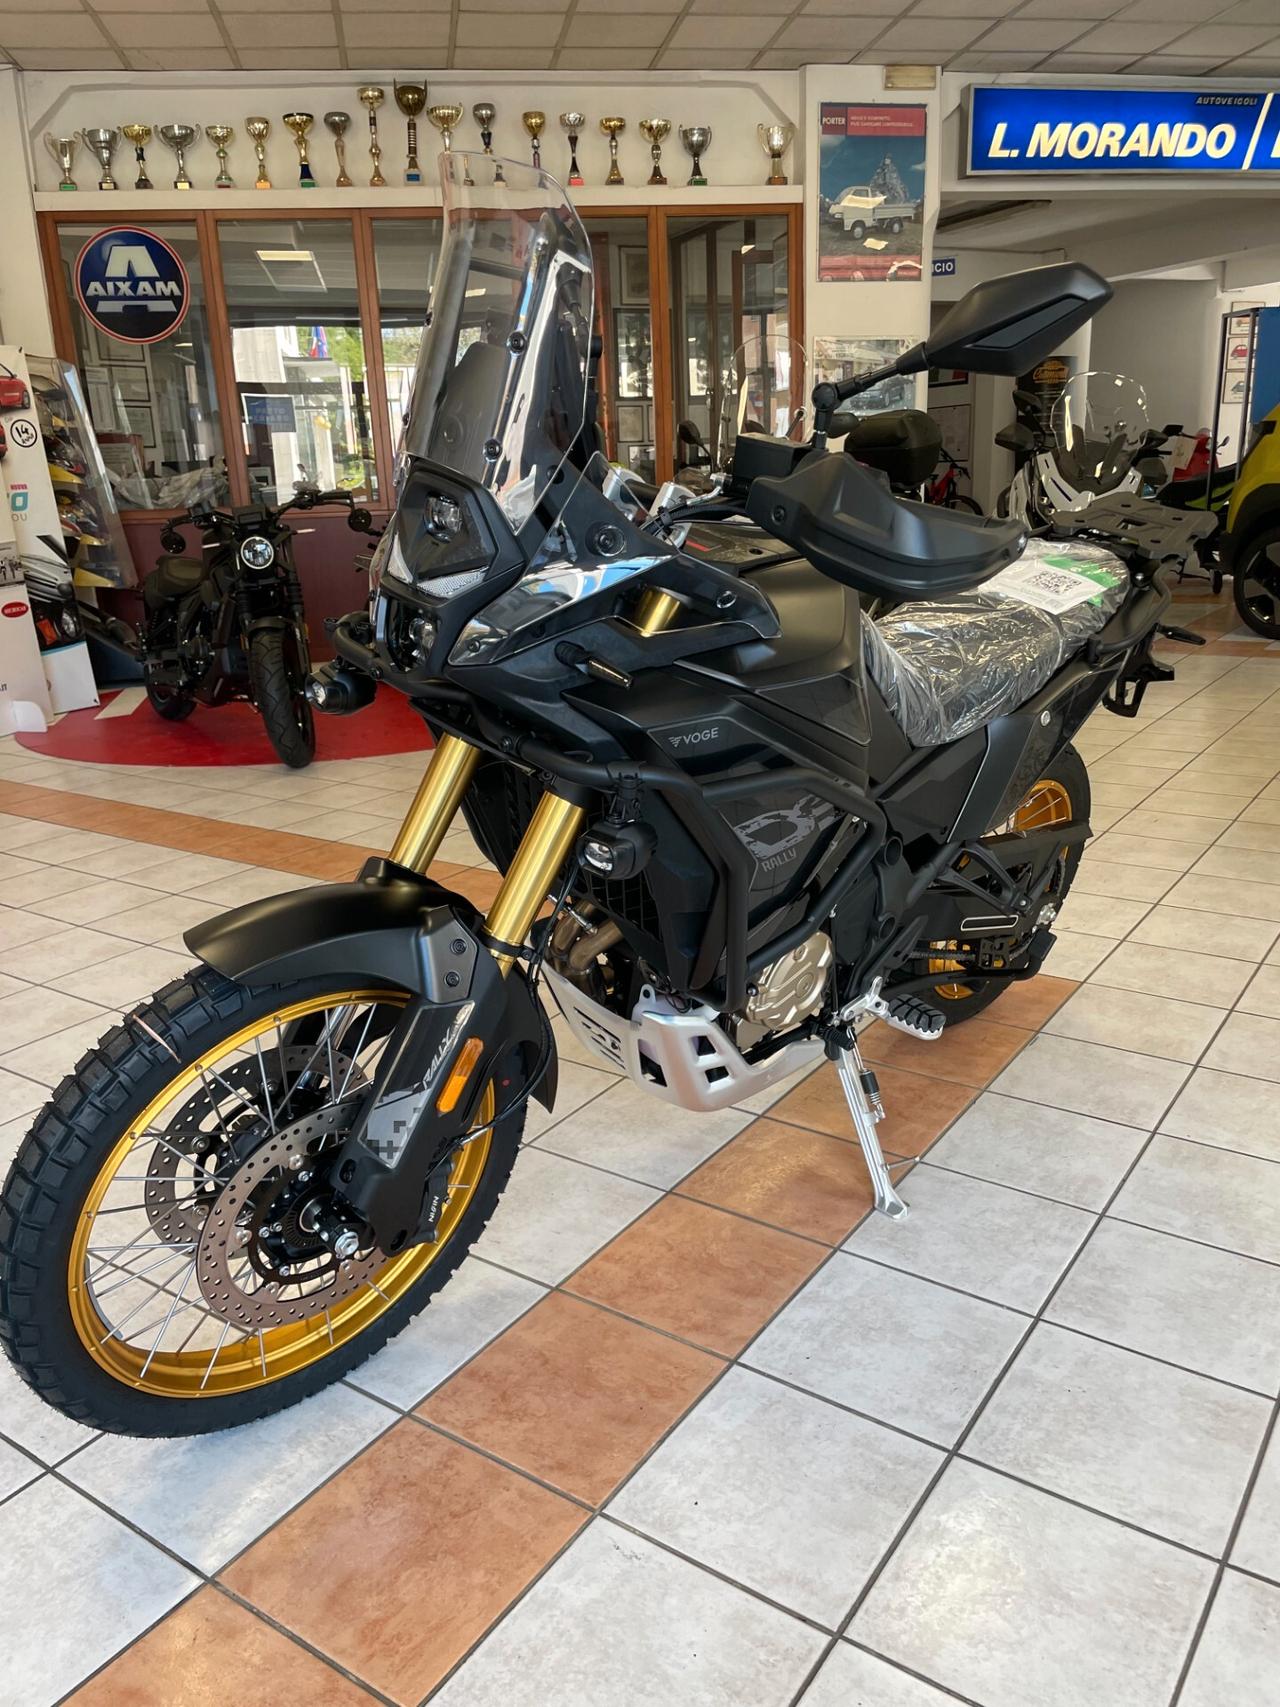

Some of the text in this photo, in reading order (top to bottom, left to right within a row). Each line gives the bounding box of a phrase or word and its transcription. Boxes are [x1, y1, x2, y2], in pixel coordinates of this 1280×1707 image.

[1195, 96, 1258, 105] AUTOVEICOLI
[822, 116, 846, 125] PORTER
[988, 122, 1019, 158] L.
[1026, 122, 1237, 160] MORANDO
[85, 281, 182, 297] AIXAM
[683, 727, 719, 745] VOGE
[761, 849, 797, 872] RALLY
[422, 1027, 452, 1090] RALLY
